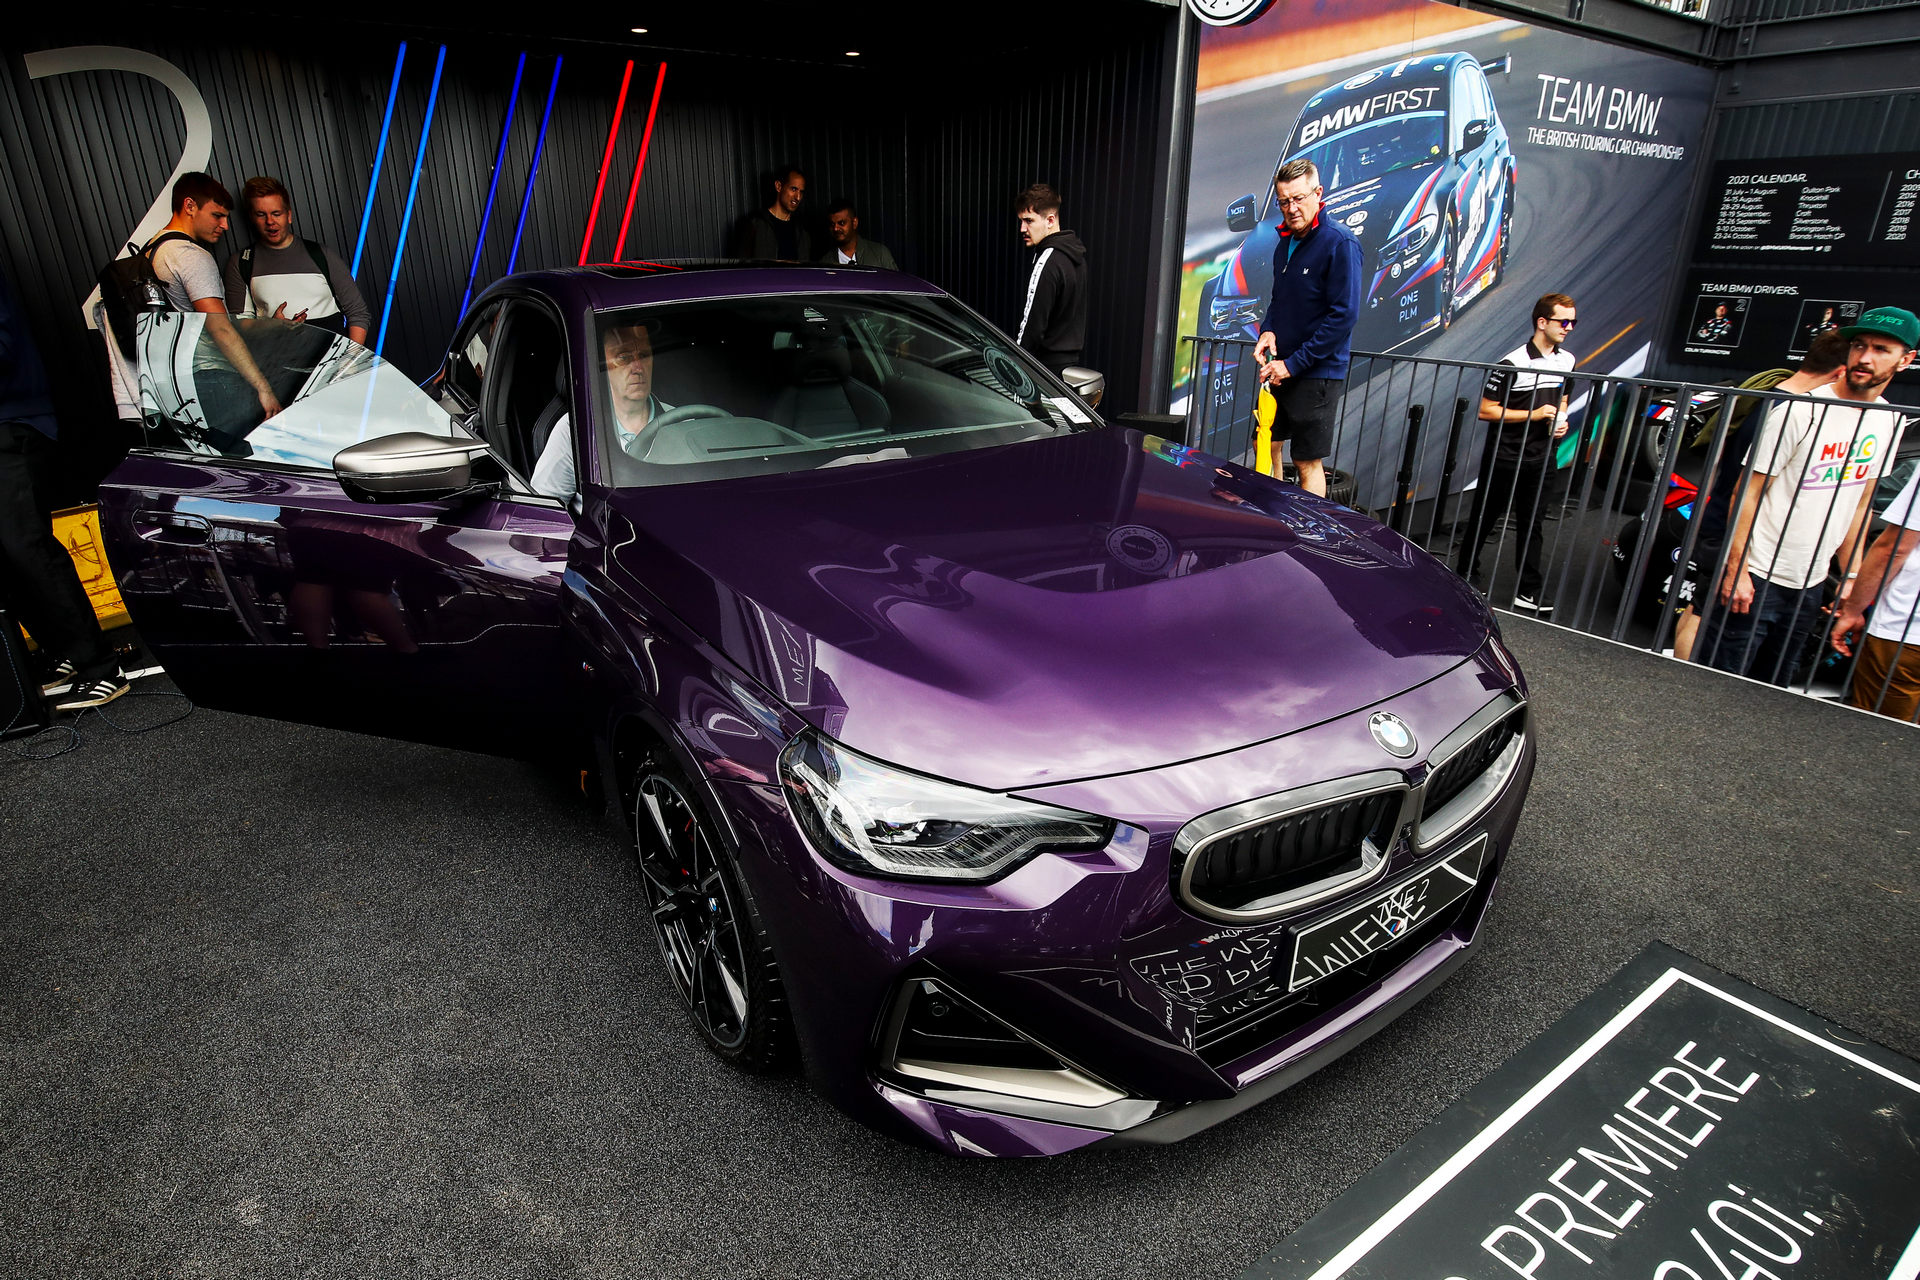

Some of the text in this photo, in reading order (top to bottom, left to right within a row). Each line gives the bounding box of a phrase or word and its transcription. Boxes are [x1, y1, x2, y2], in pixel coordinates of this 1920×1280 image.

[1537, 73, 1663, 136] TEAM BMW.
[1528, 127, 1548, 145] THE
[1546, 129, 1582, 148] BRITISH
[1581, 133, 1617, 153] TOURING
[1615, 138, 1633, 155] CAR
[1727, 175, 1750, 185] 2021
[1701, 283, 1728, 292] TEAM
[1728, 284, 1754, 293] BMW
[1400, 290, 1419, 307] ONE
[1735, 299, 1747, 312] 2
[1399, 305, 1418, 323] PLM
[1480, 1040, 1760, 1280] PREMIERE
